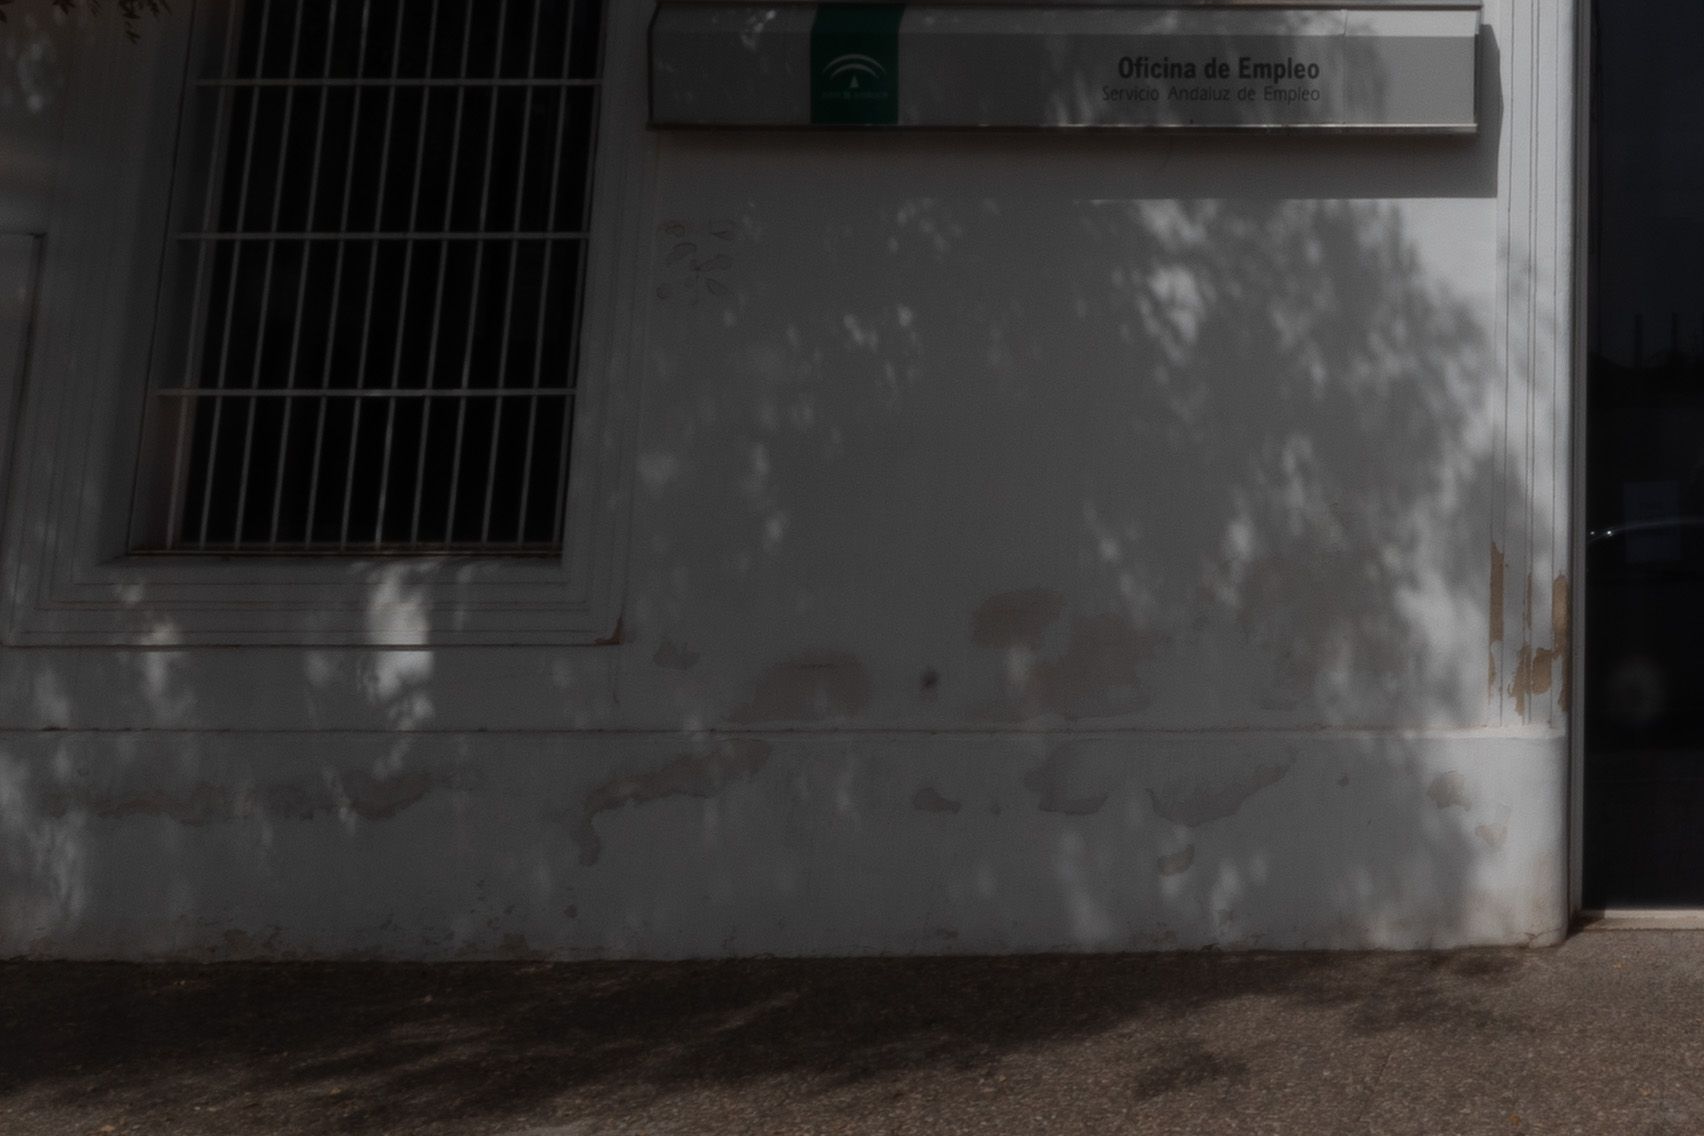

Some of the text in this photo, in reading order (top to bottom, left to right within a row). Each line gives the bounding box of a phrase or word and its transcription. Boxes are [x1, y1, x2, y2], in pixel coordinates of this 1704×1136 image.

[1118, 56, 1320, 84] Oficina de Empleo
[1102, 85, 1320, 105] Servicio Andaluz de Empleo
